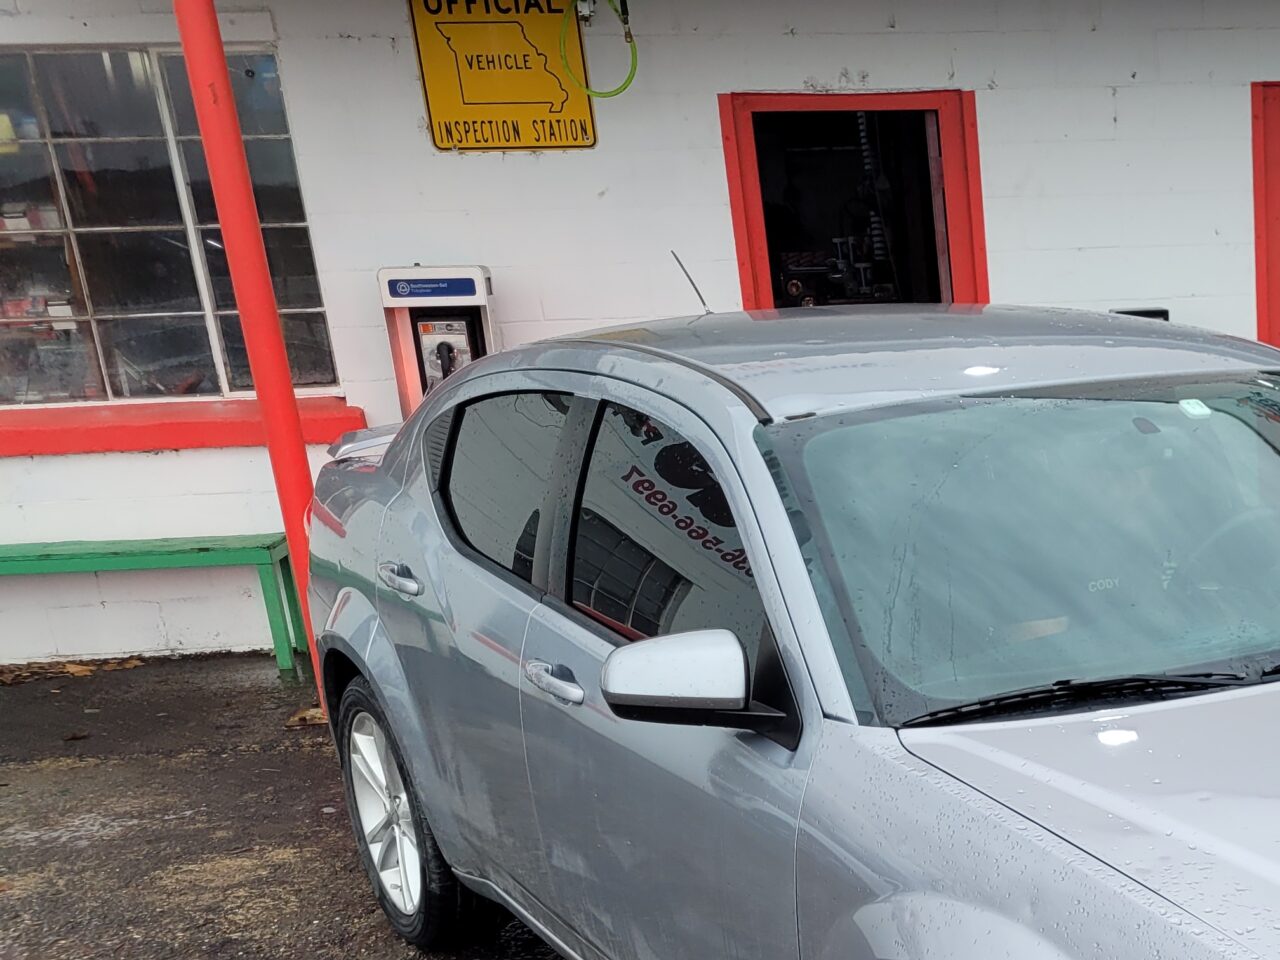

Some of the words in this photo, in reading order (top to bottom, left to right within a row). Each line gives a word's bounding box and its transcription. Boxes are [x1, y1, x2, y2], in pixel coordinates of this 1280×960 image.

[464, 54, 532, 70] VEHICLE
[438, 120, 521, 144] INSPECTION
[532, 118, 588, 143] STATION
[1088, 576, 1120, 592] CODY
